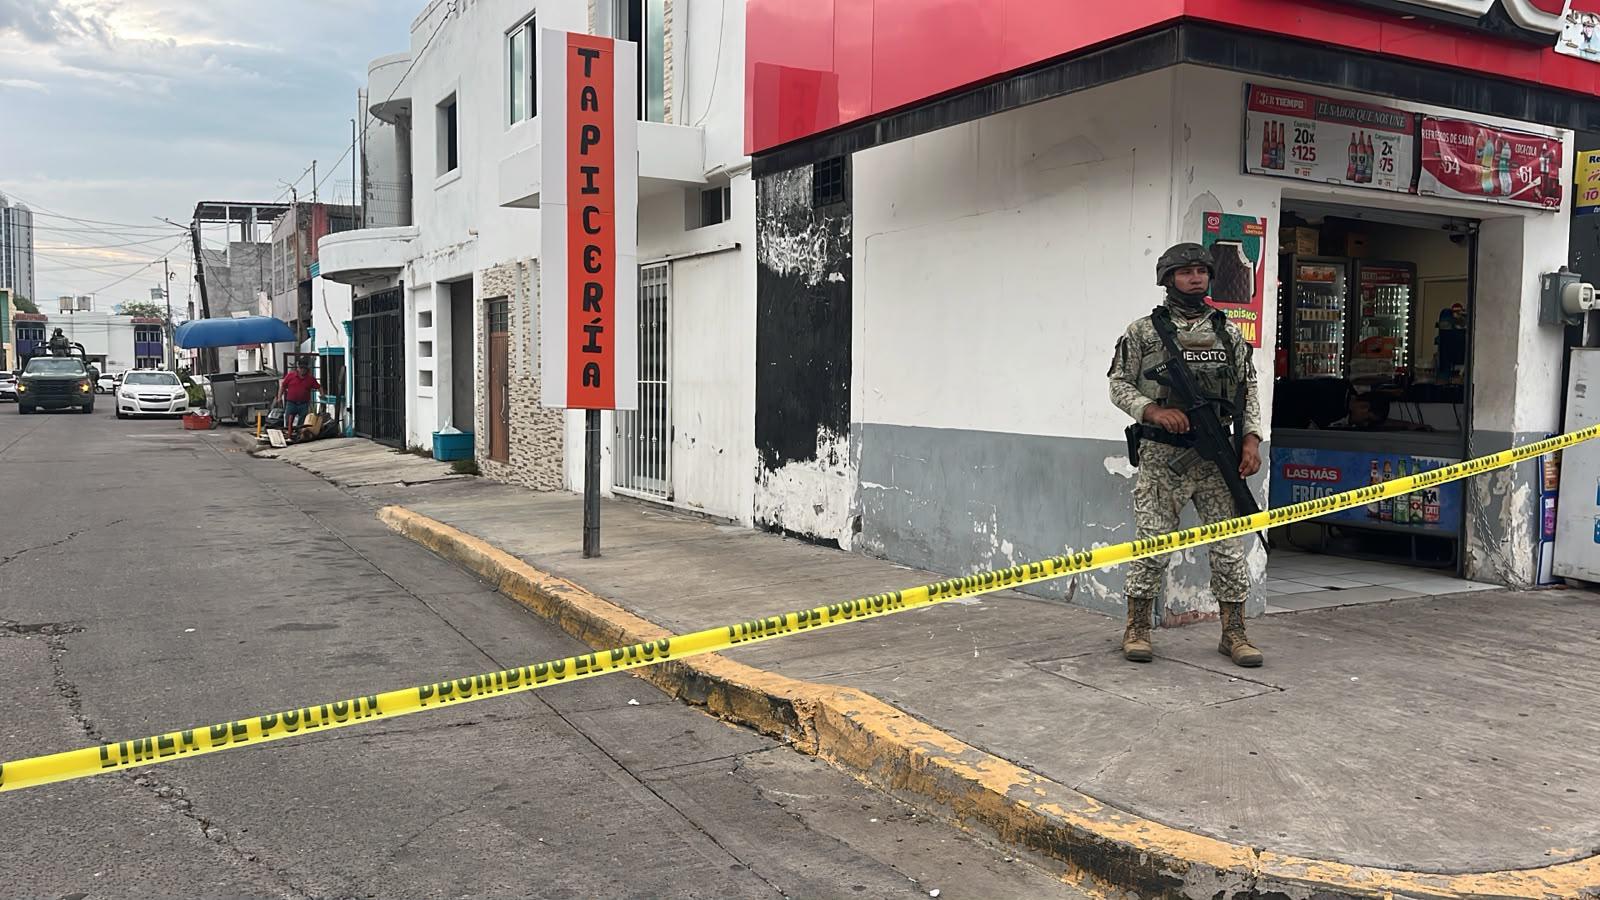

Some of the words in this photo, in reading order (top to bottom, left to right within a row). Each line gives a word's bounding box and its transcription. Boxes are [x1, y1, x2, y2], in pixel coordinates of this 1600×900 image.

[1275, 96, 1304, 109] TIEMPO
[1329, 104, 1357, 120] SABOR
[1357, 107, 1374, 122] QUE
[1375, 112, 1389, 124] NOS
[1389, 113, 1405, 128] UNE
[1450, 133, 1457, 143] DE
[1458, 134, 1474, 146] SABOR
[1291, 145, 1316, 161] $125
[1378, 157, 1393, 172] $75
[577, 48, 604, 388] TAPICERÍA
[1286, 468, 1309, 479] LAS
[1310, 467, 1338, 480] MÁS
